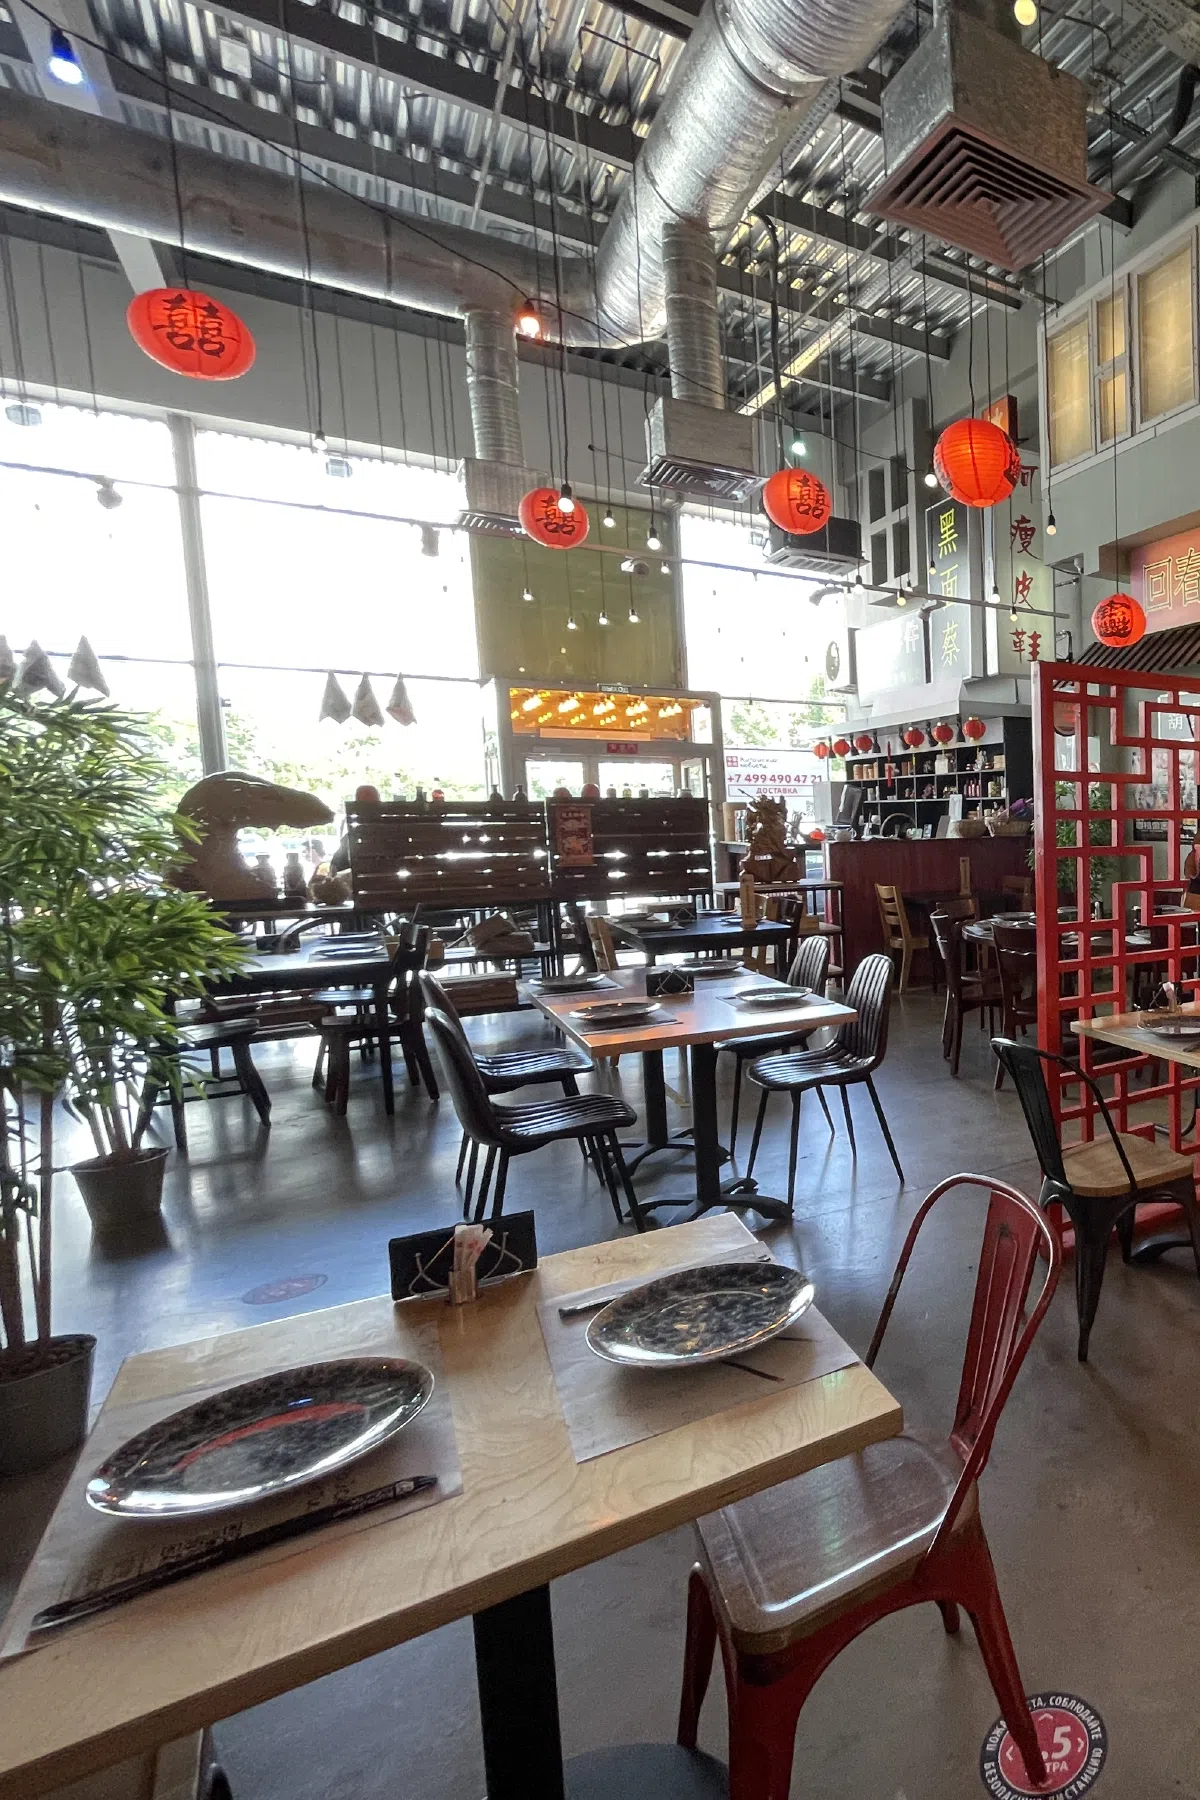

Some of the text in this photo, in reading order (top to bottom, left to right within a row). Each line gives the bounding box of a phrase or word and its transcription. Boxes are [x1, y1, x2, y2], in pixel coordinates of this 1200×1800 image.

[937, 507, 961, 668] 黑面蔡
[727, 774, 742, 783] +7
[744, 774, 767, 783] 499
[769, 774, 792, 784] 490
[794, 775, 807, 784] 47
[755, 787, 798, 795] ДОСТАВКА
[1049, 1695, 1104, 1741] СОБЛЮДАЙТЕ
